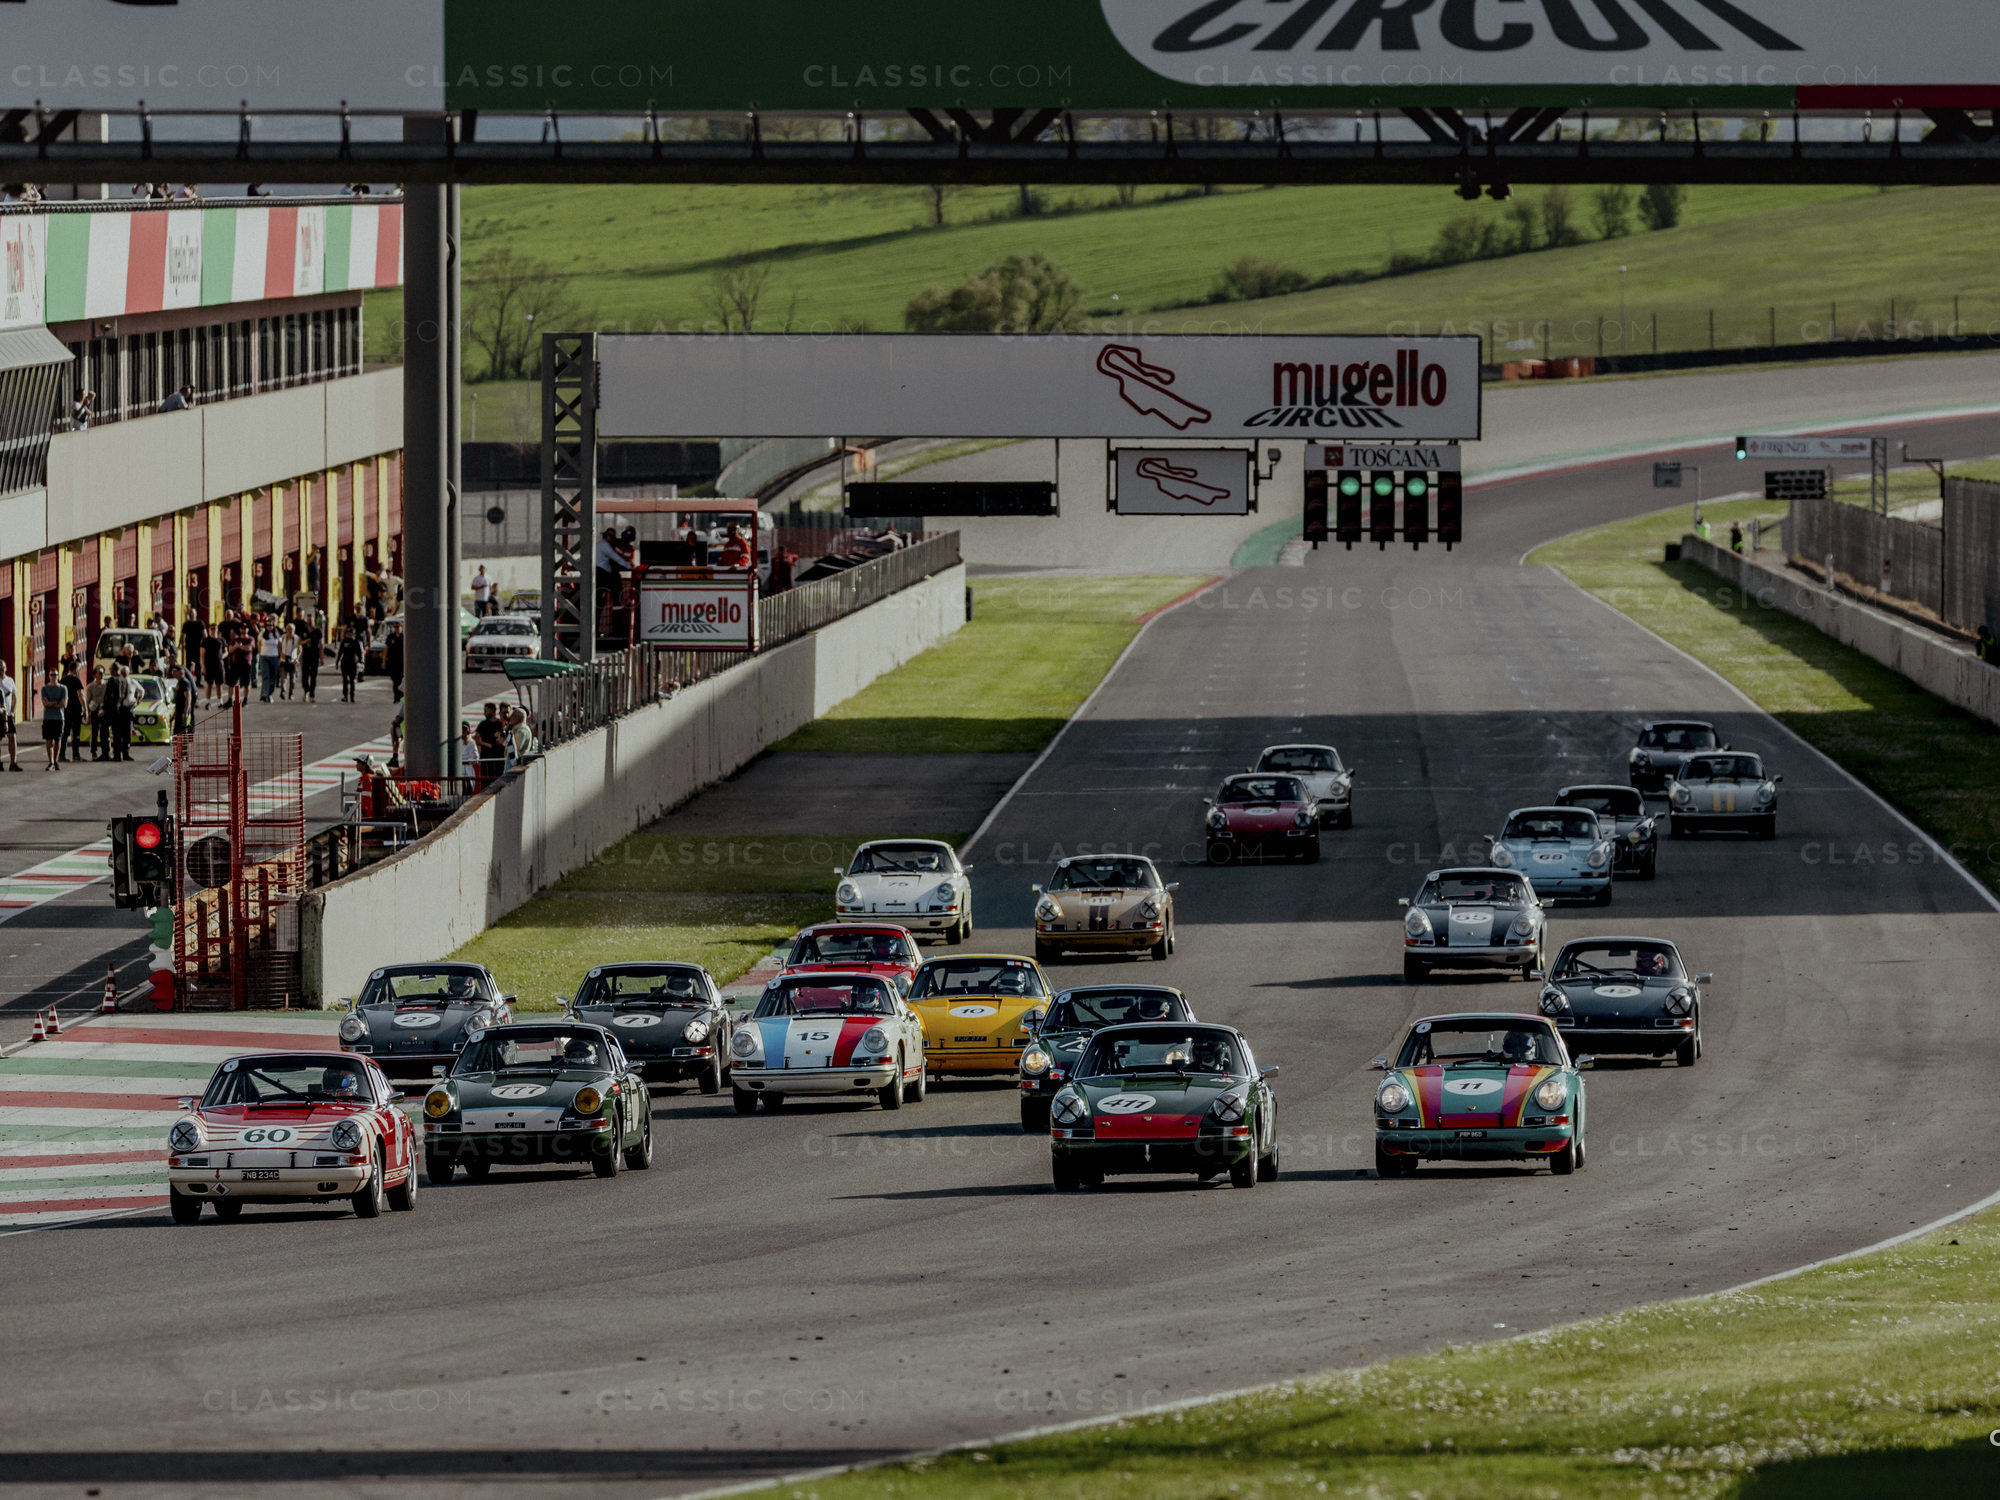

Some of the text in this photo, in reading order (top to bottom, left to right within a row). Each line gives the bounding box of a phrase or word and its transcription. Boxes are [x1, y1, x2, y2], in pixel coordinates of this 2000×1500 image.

[1273, 349, 1447, 407] mugello
[1243, 407, 1404, 428] CIRCUIT
[1351, 449, 1440, 467] TOSCANA
[221, 567, 232, 582] 14
[252, 563, 263, 576] 15
[152, 579, 163, 594] 12
[187, 573, 199, 587] 13
[113, 585, 124, 600] 11
[72, 592, 84, 608] 10
[31, 600, 40, 615] 9
[661, 597, 741, 624] mugello
[648, 623, 720, 633] CIRCUIT
[796, 1031, 829, 1041] 15
[499, 1086, 541, 1095] 777
[1459, 1082, 1483, 1090] 11
[1103, 1098, 1151, 1109] 411
[244, 1129, 291, 1143] 60
[241, 1171, 280, 1179] FNB 234C
